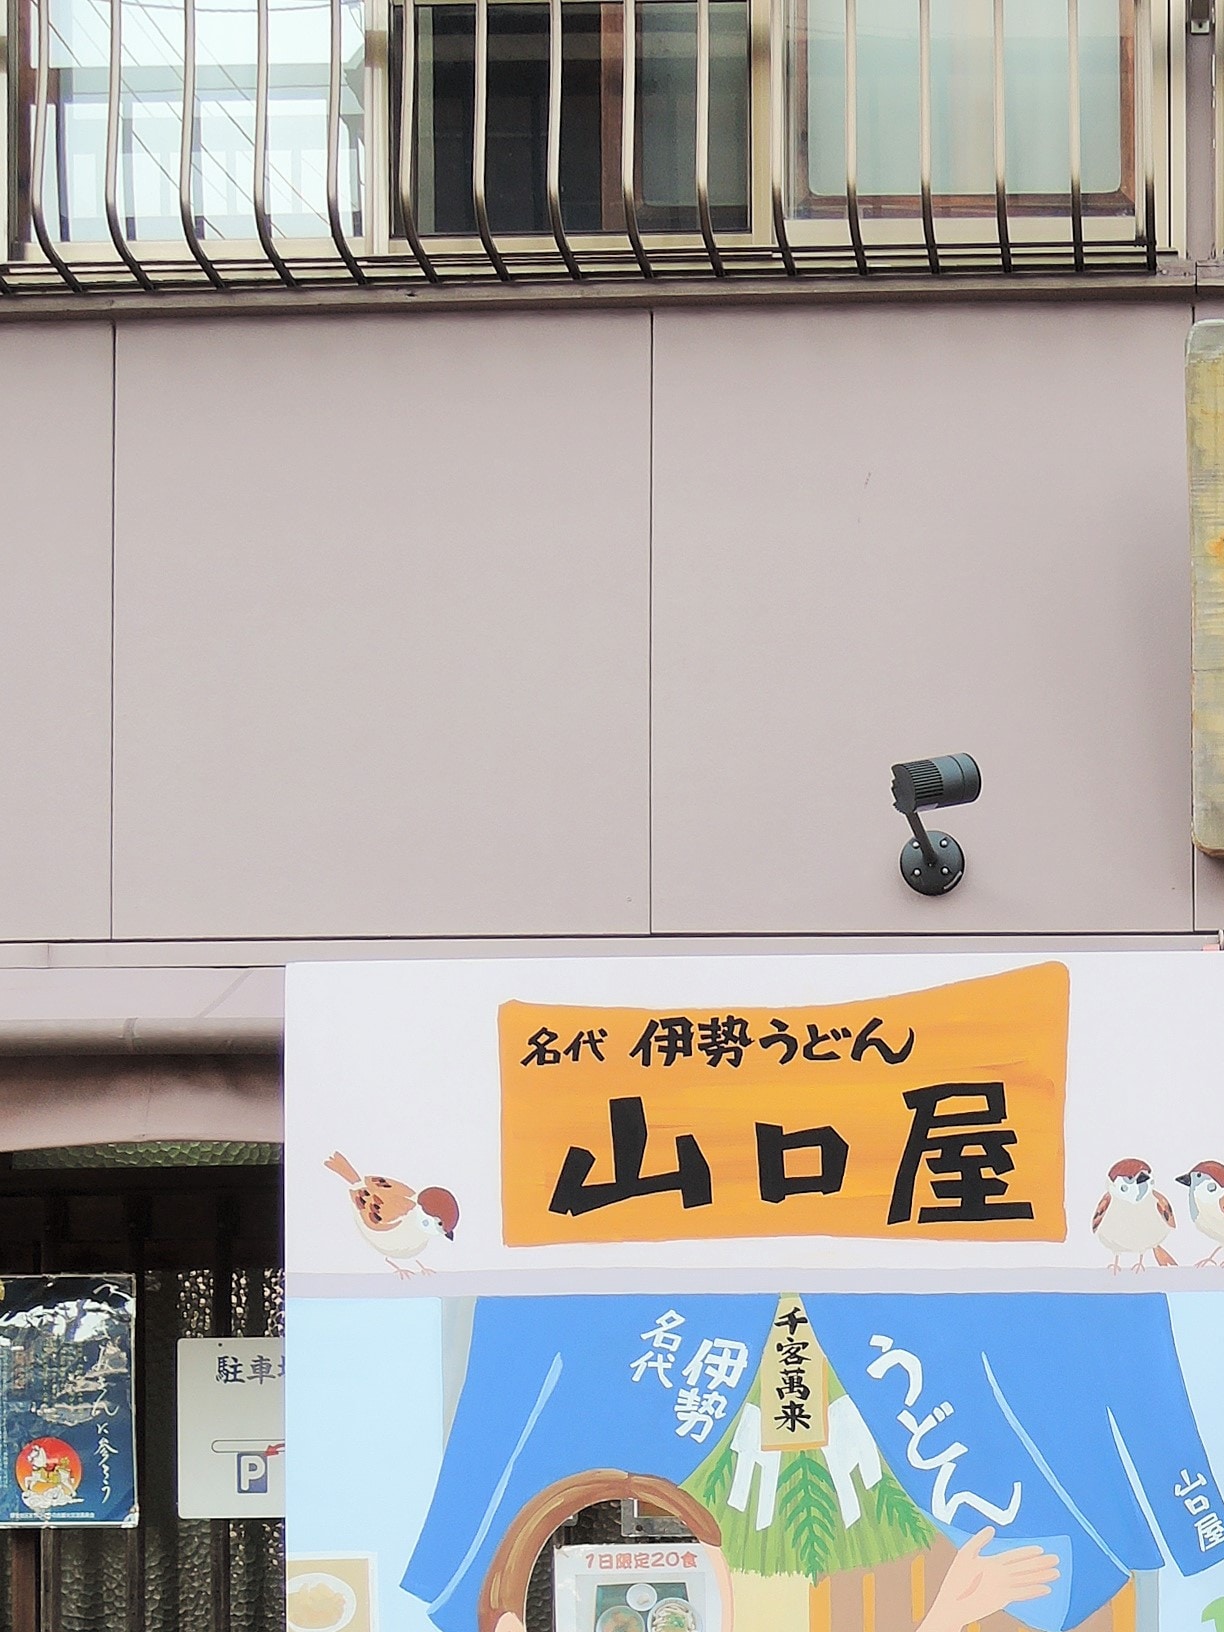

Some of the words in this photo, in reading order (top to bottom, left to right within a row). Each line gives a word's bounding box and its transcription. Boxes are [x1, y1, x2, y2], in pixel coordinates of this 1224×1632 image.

[519, 1026, 609, 1067] 名代
[630, 1015, 915, 1068] 伊勢うどん
[547, 1081, 1035, 1226] 山口屋
[215, 1354, 286, 1385] 駐車
[773, 1306, 813, 1433] 千客萬来
[629, 1309, 686, 1389] 名代
[673, 1337, 749, 1443] 伊勢
[867, 1334, 1023, 1526] うどん
[240, 1455, 265, 1491] P
[585, 1551, 698, 1570] 1日限定20食
